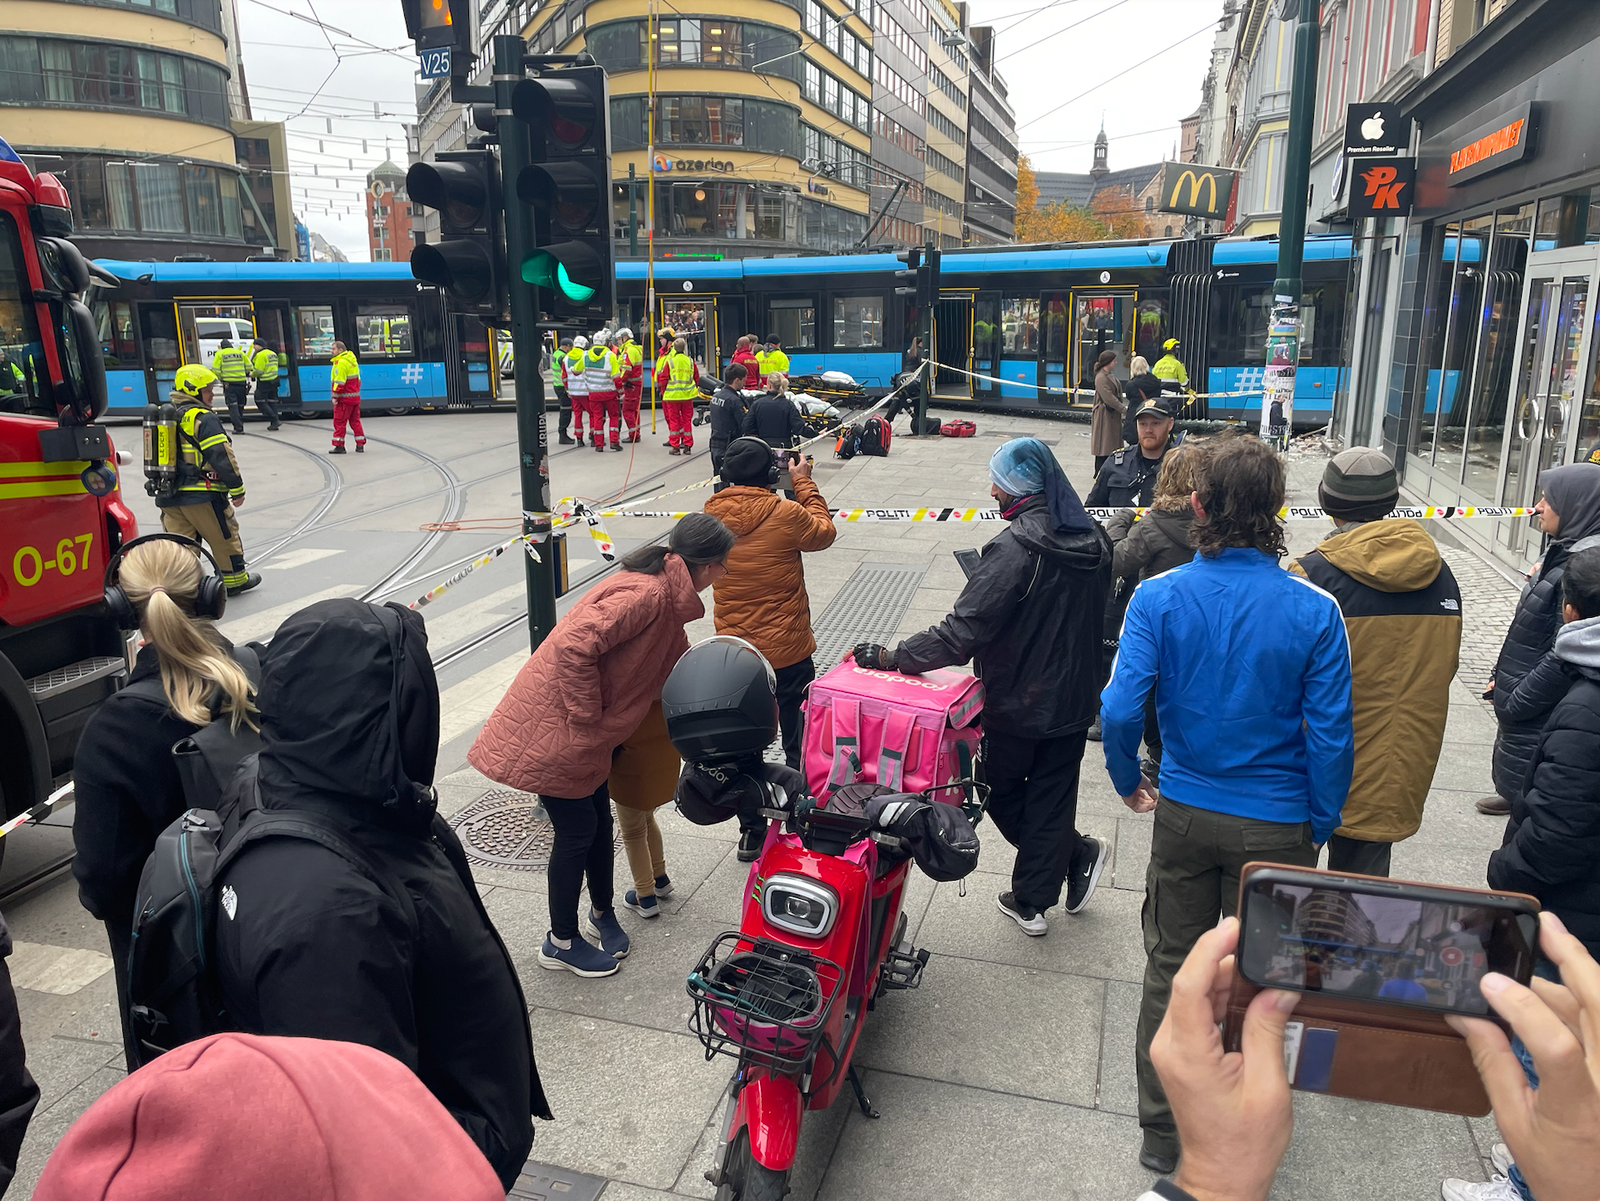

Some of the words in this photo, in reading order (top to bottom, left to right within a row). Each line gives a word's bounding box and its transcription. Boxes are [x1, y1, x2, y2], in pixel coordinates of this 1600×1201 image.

[421, 52, 450, 75] V25
[1359, 166, 1406, 209] PK
[866, 510, 910, 518] POLITI
[1088, 509, 1118, 517] POLI
[1291, 508, 1323, 516] POLIT
[1477, 507, 1512, 515] POLITI
[979, 512, 1004, 520] LITI
[13, 532, 94, 587] O-67
[852, 667, 949, 692] foodora
